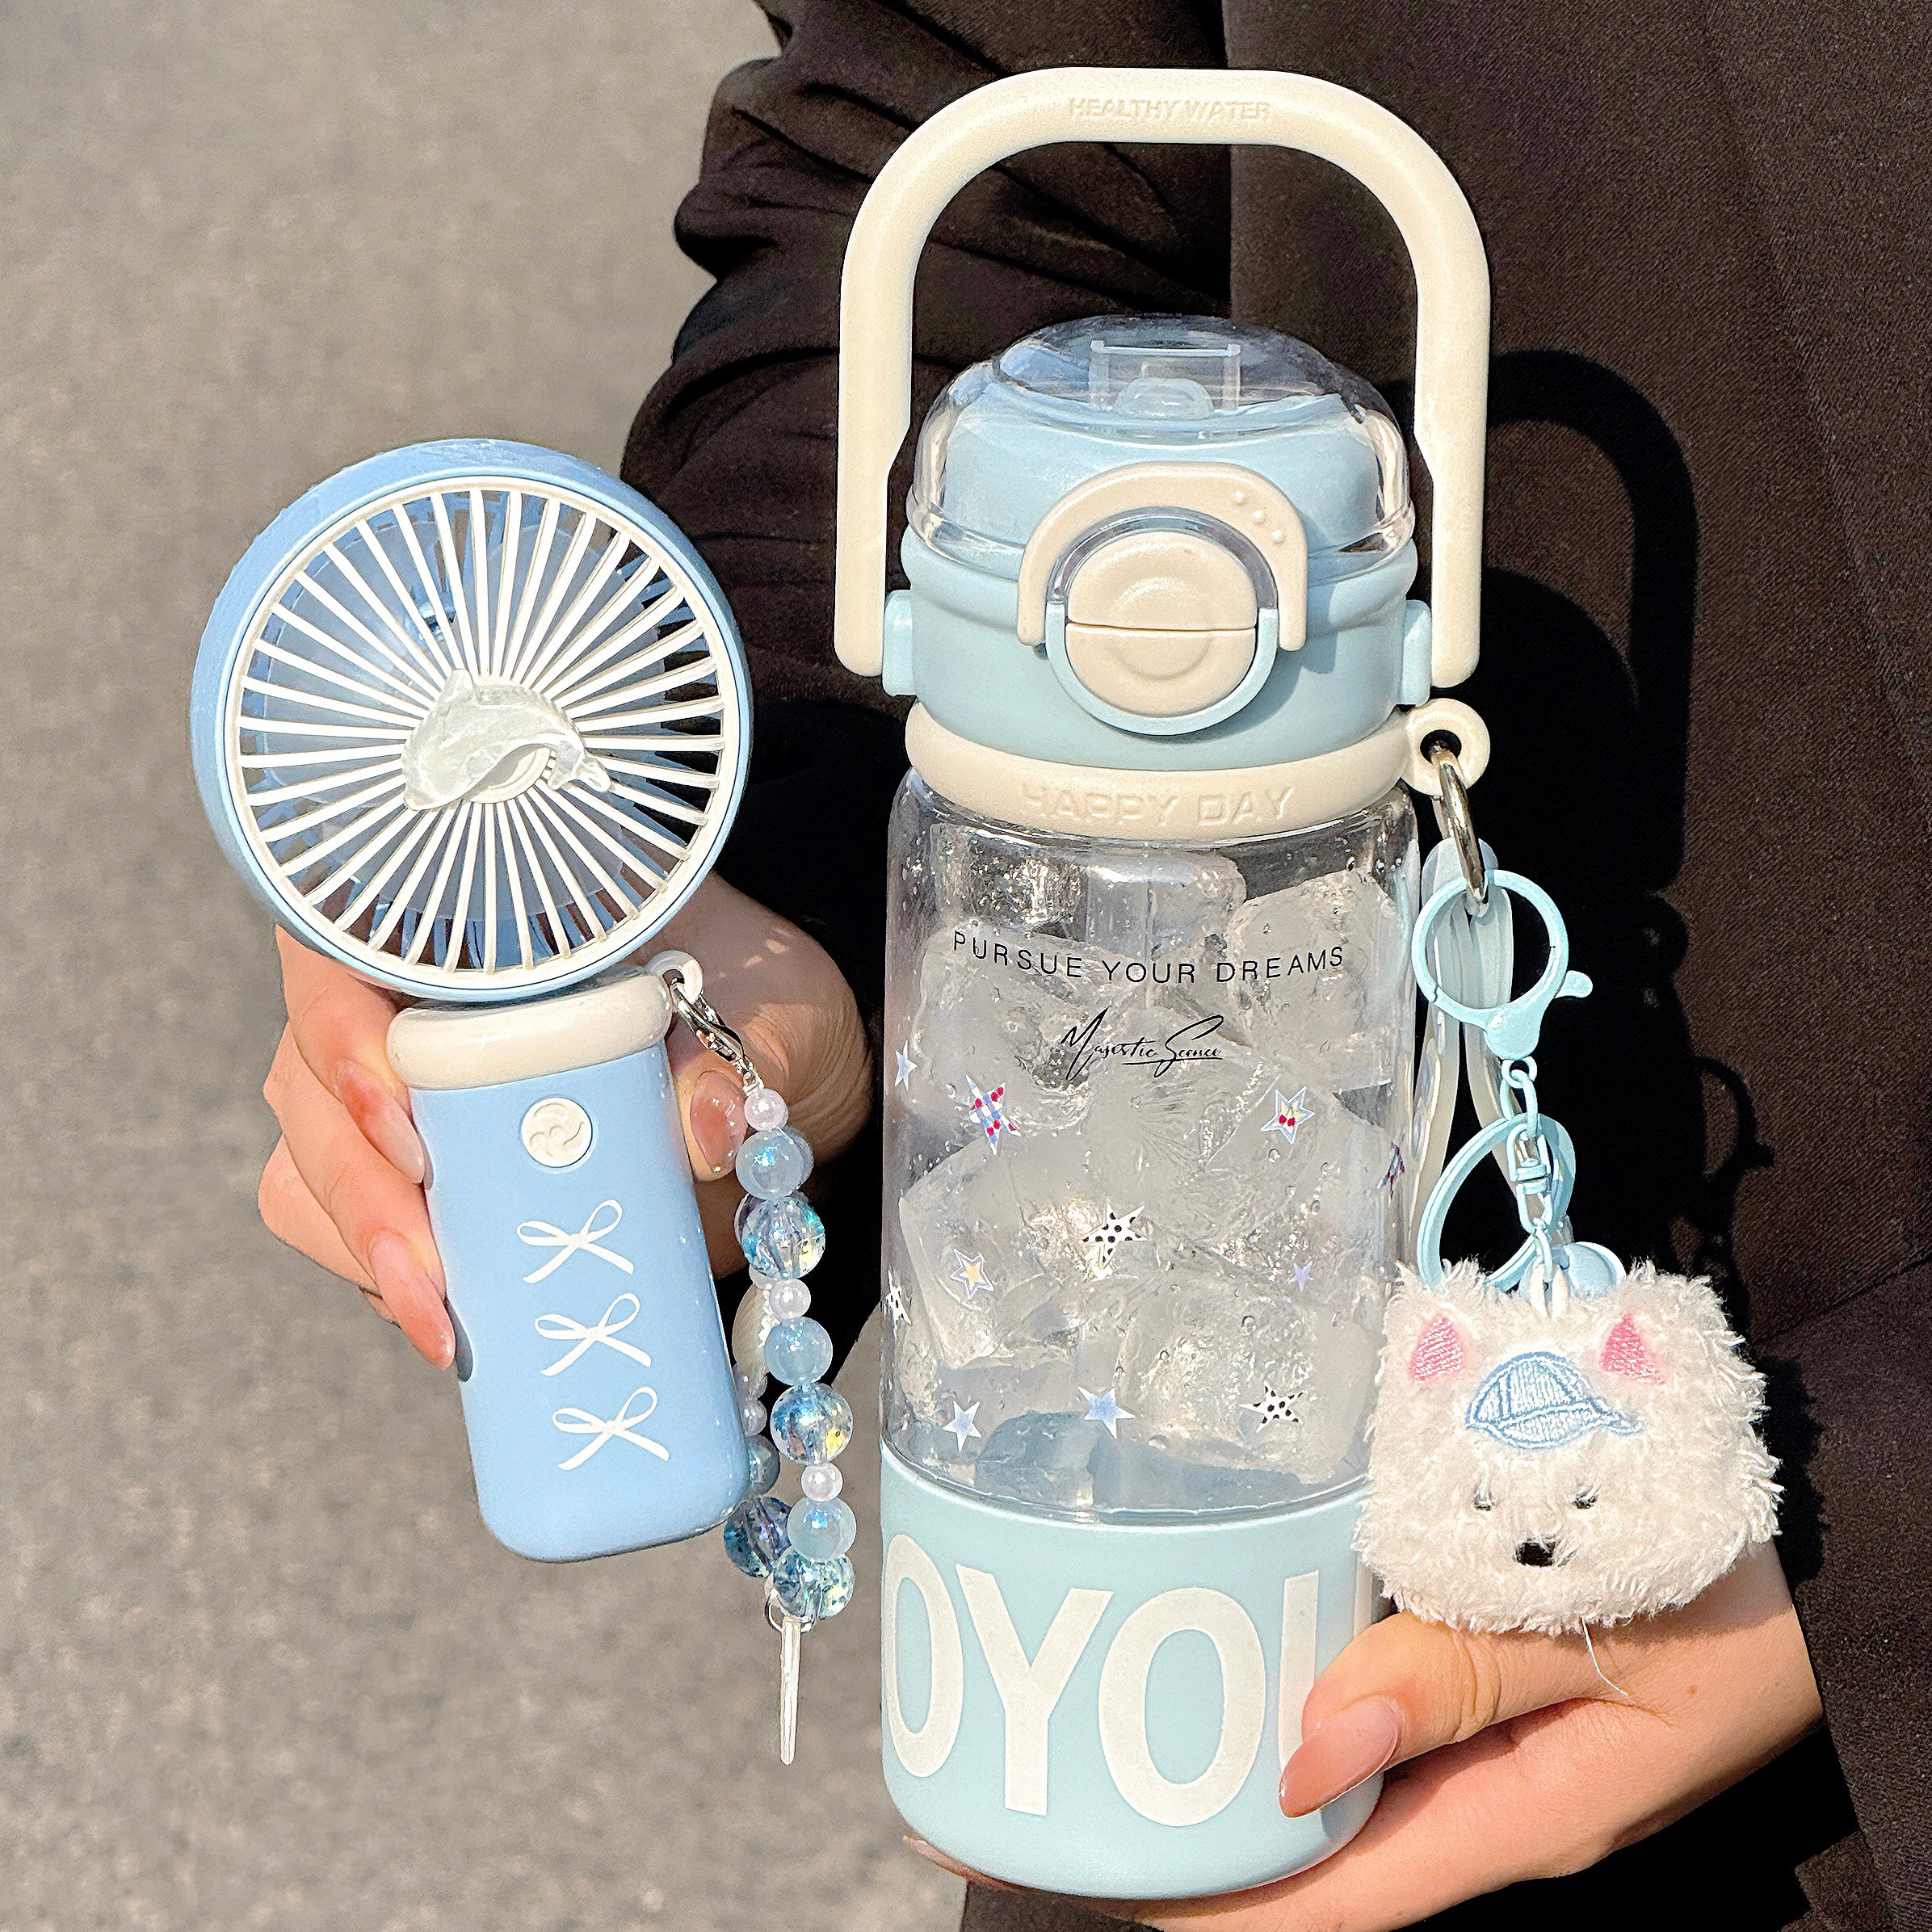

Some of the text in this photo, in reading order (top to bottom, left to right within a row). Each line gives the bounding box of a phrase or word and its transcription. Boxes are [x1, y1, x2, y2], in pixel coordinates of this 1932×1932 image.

[1069, 97, 1270, 120] HEALTHY WATER
[1022, 782, 1293, 827] HAPPY DAY
[953, 930, 1344, 985] PURSUE YOUR DREAMS
